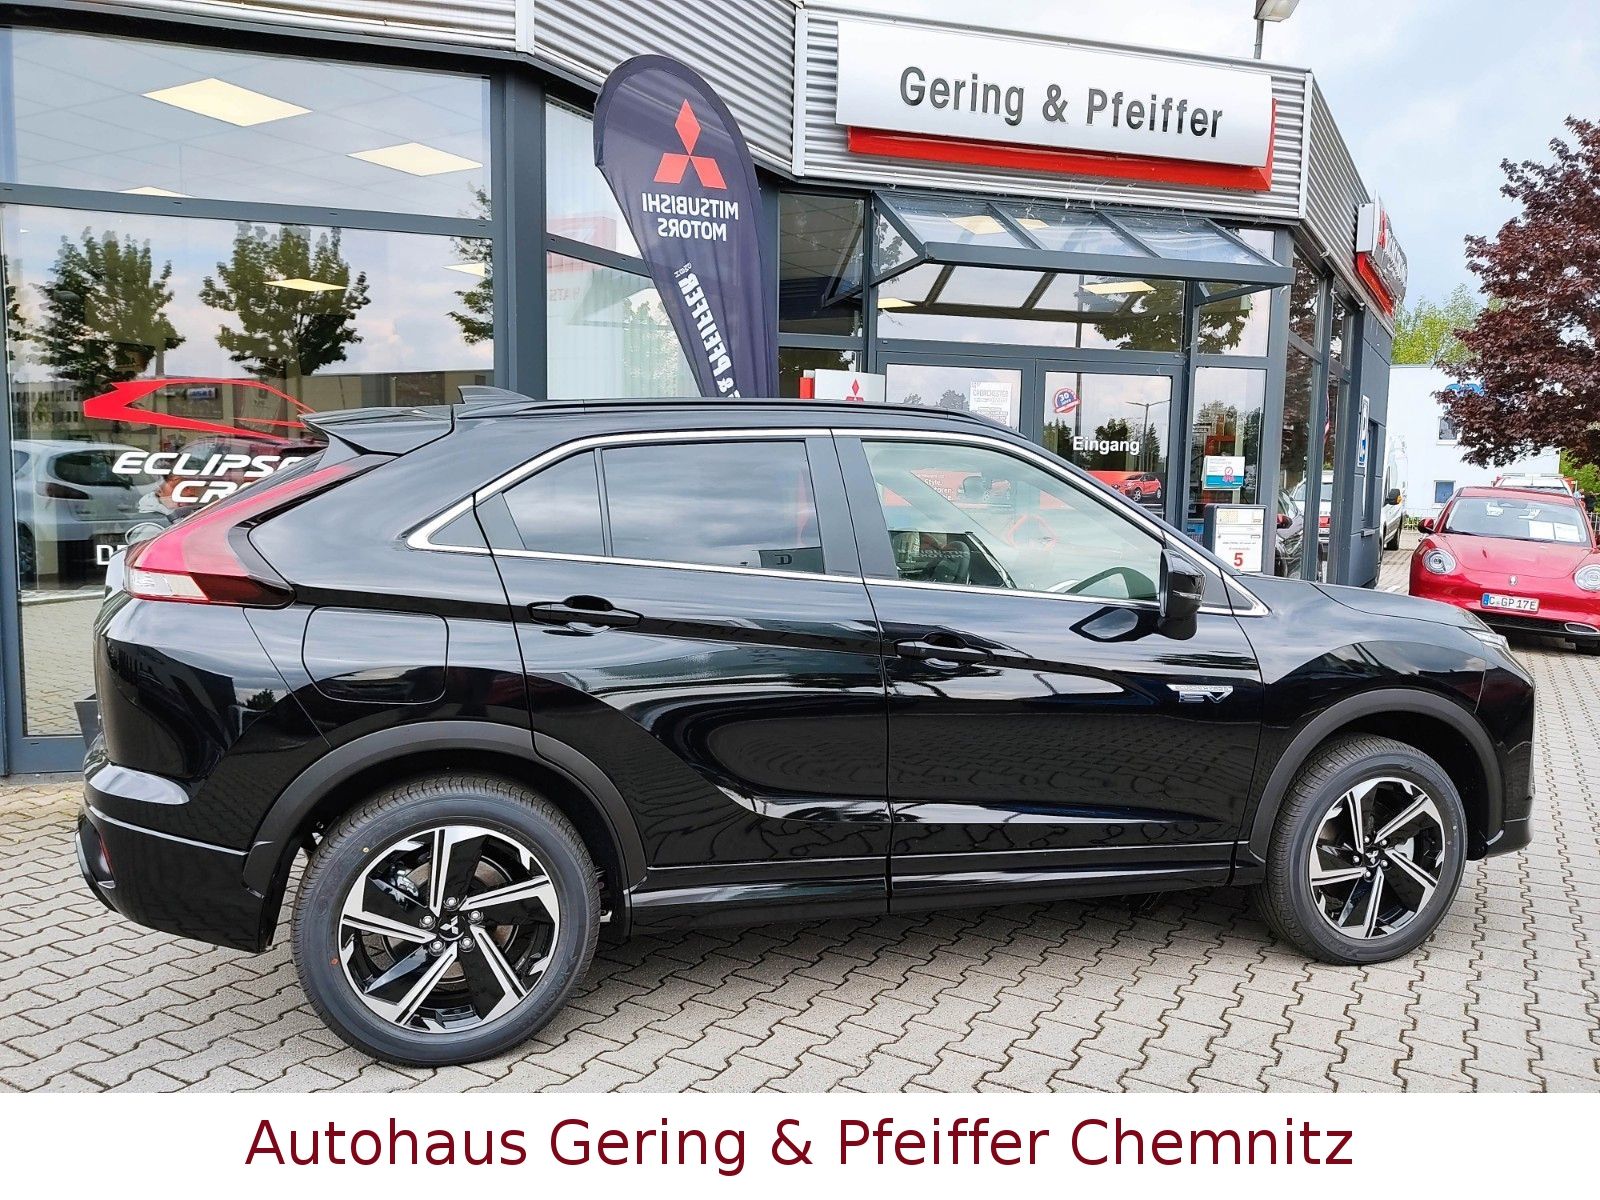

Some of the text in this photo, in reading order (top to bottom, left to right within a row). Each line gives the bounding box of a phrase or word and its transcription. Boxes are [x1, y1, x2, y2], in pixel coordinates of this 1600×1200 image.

[900, 66, 1223, 138] Gering & Pfeiffer
[1058, 392, 1070, 402] 30
[1072, 436, 1140, 456] Eingang
[171, 480, 253, 504] CR
[1233, 552, 1244, 567] 5
